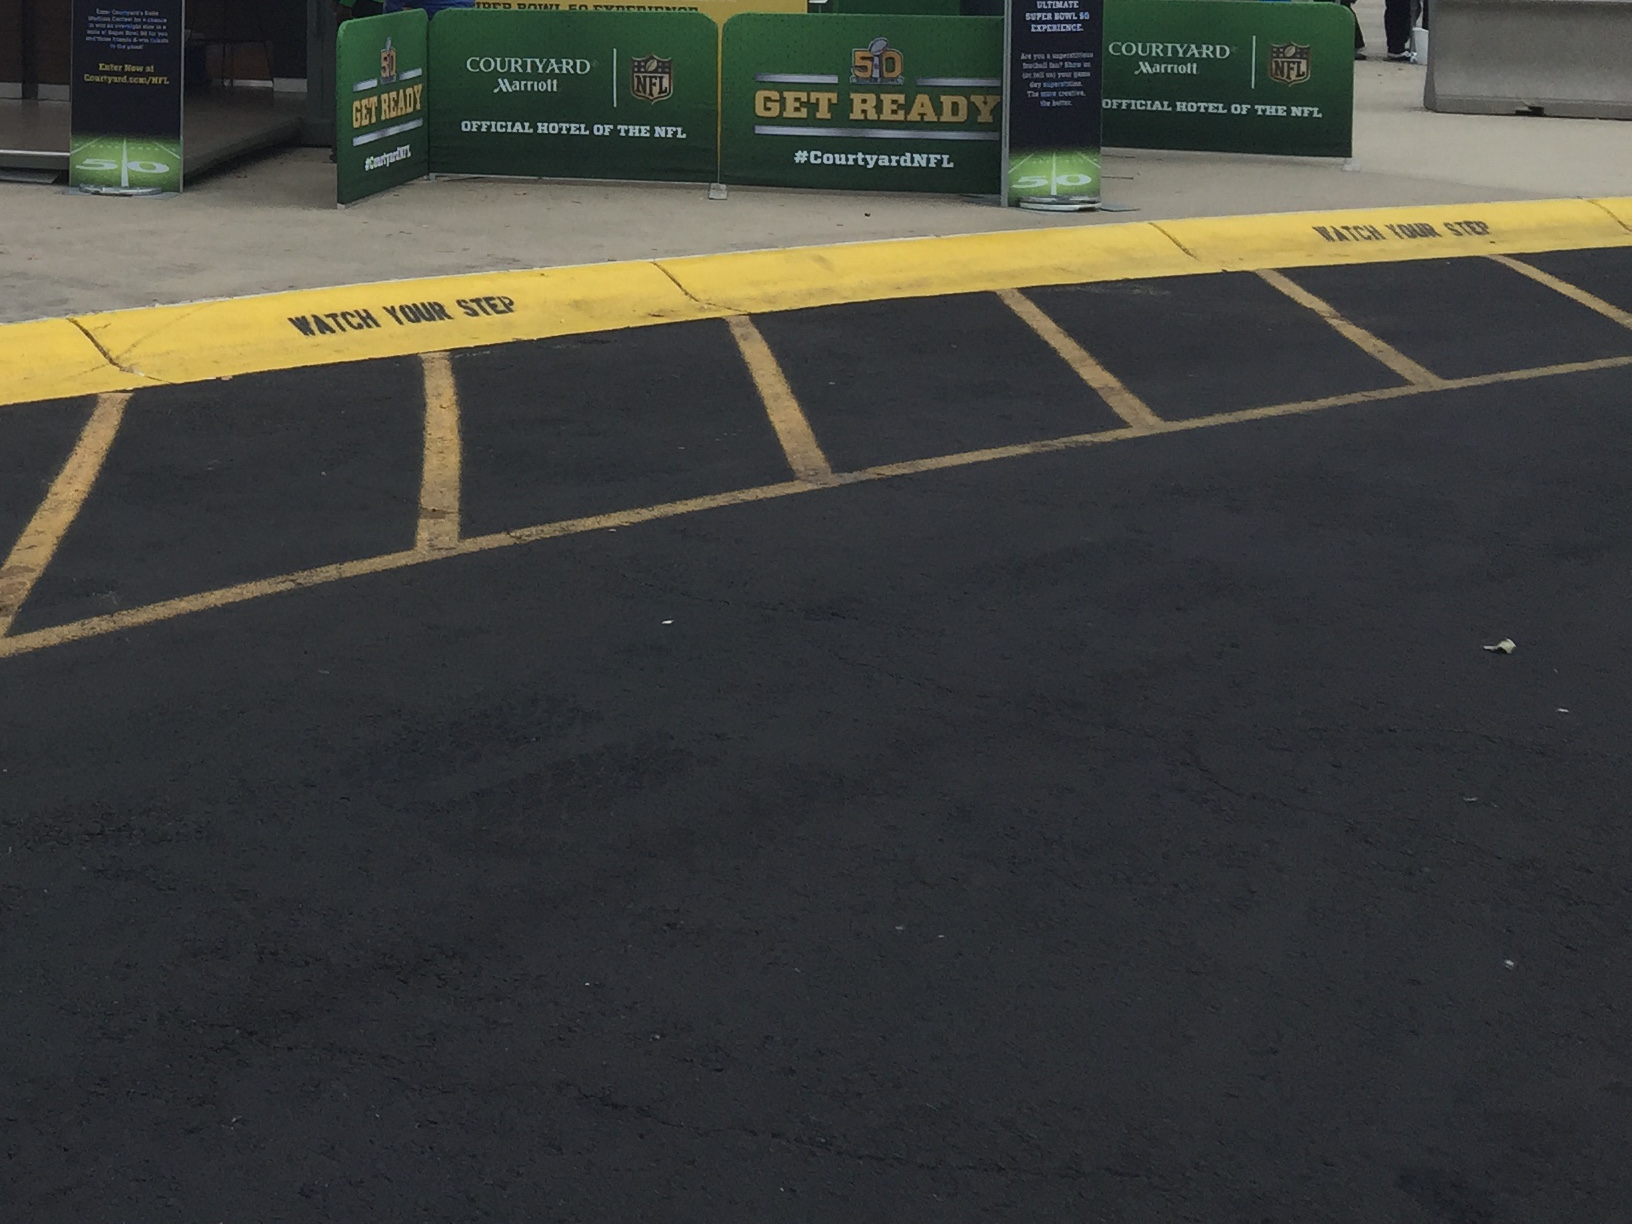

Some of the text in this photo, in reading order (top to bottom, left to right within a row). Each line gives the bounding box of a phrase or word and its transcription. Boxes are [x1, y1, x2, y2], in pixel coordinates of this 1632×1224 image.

[1037, 0, 1079, 9] ULTIMATE
[1108, 41, 1231, 60] COURTYARD
[466, 56, 591, 75] COURTYARD
[852, 47, 903, 79] 50
[1134, 61, 1198, 75] Marriott
[1272, 59, 1307, 80] NFL
[493, 77, 558, 94] Marriott
[634, 72, 670, 99] NFL
[353, 83, 423, 128] GET READY
[754, 89, 1001, 123] GET READY
[1102, 98, 1323, 119] OFFICIAL HOTEL OF THE NFL
[460, 119, 687, 139] OFFICIAL HOTEL OF THE NFL
[75, 158, 170, 173] 50
[794, 149, 954, 169] #CourtyardNFL
[1011, 173, 1092, 189] 50
[1312, 220, 1490, 242] WATCH YOUR STEP
[288, 295, 515, 337] WATCH YOUR STEP
